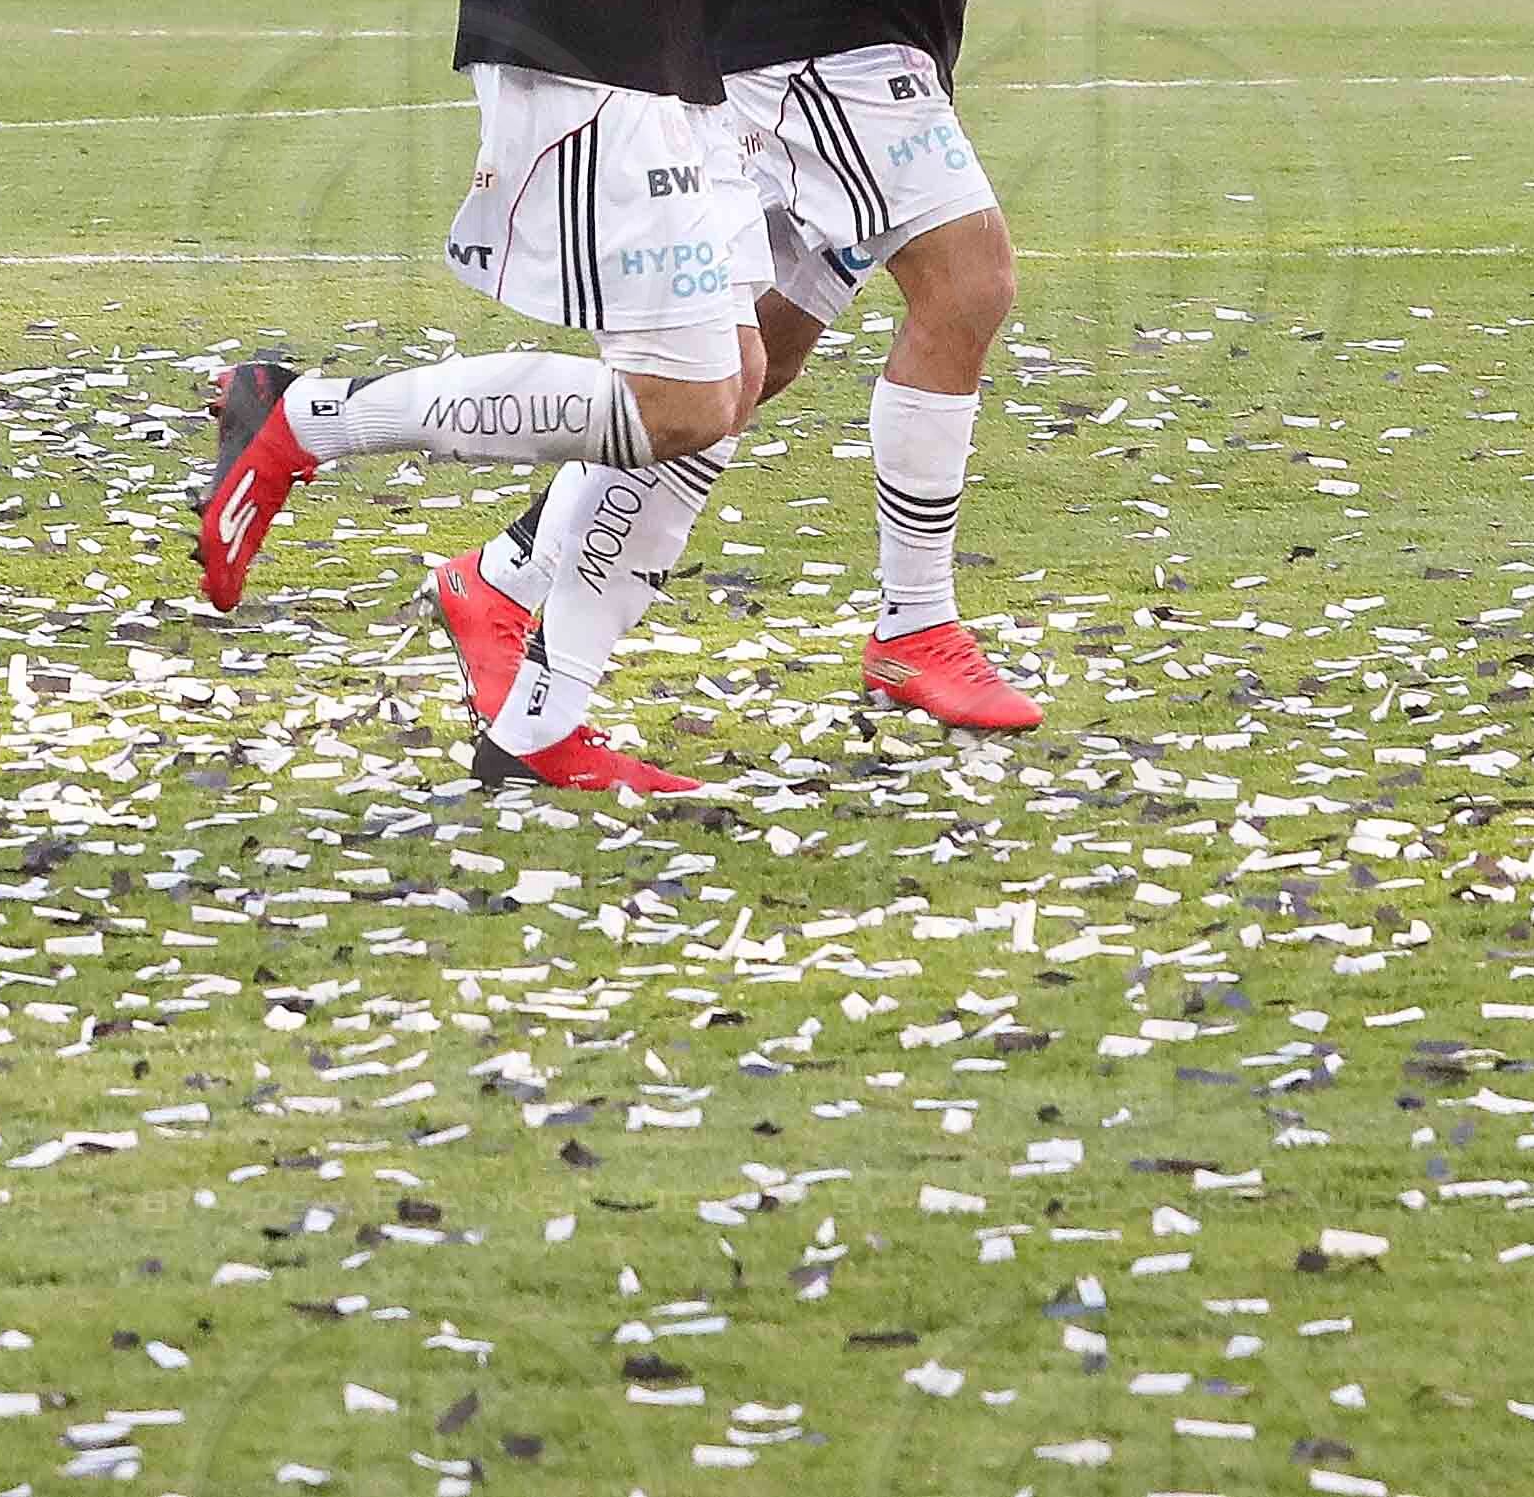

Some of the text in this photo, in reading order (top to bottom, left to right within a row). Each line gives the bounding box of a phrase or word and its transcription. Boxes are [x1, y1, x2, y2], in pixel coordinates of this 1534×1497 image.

[646, 165, 702, 198] BW
[619, 239, 715, 277] HYPO
[421, 393, 524, 437] MOLTO
[576, 483, 643, 597] MOLTO
